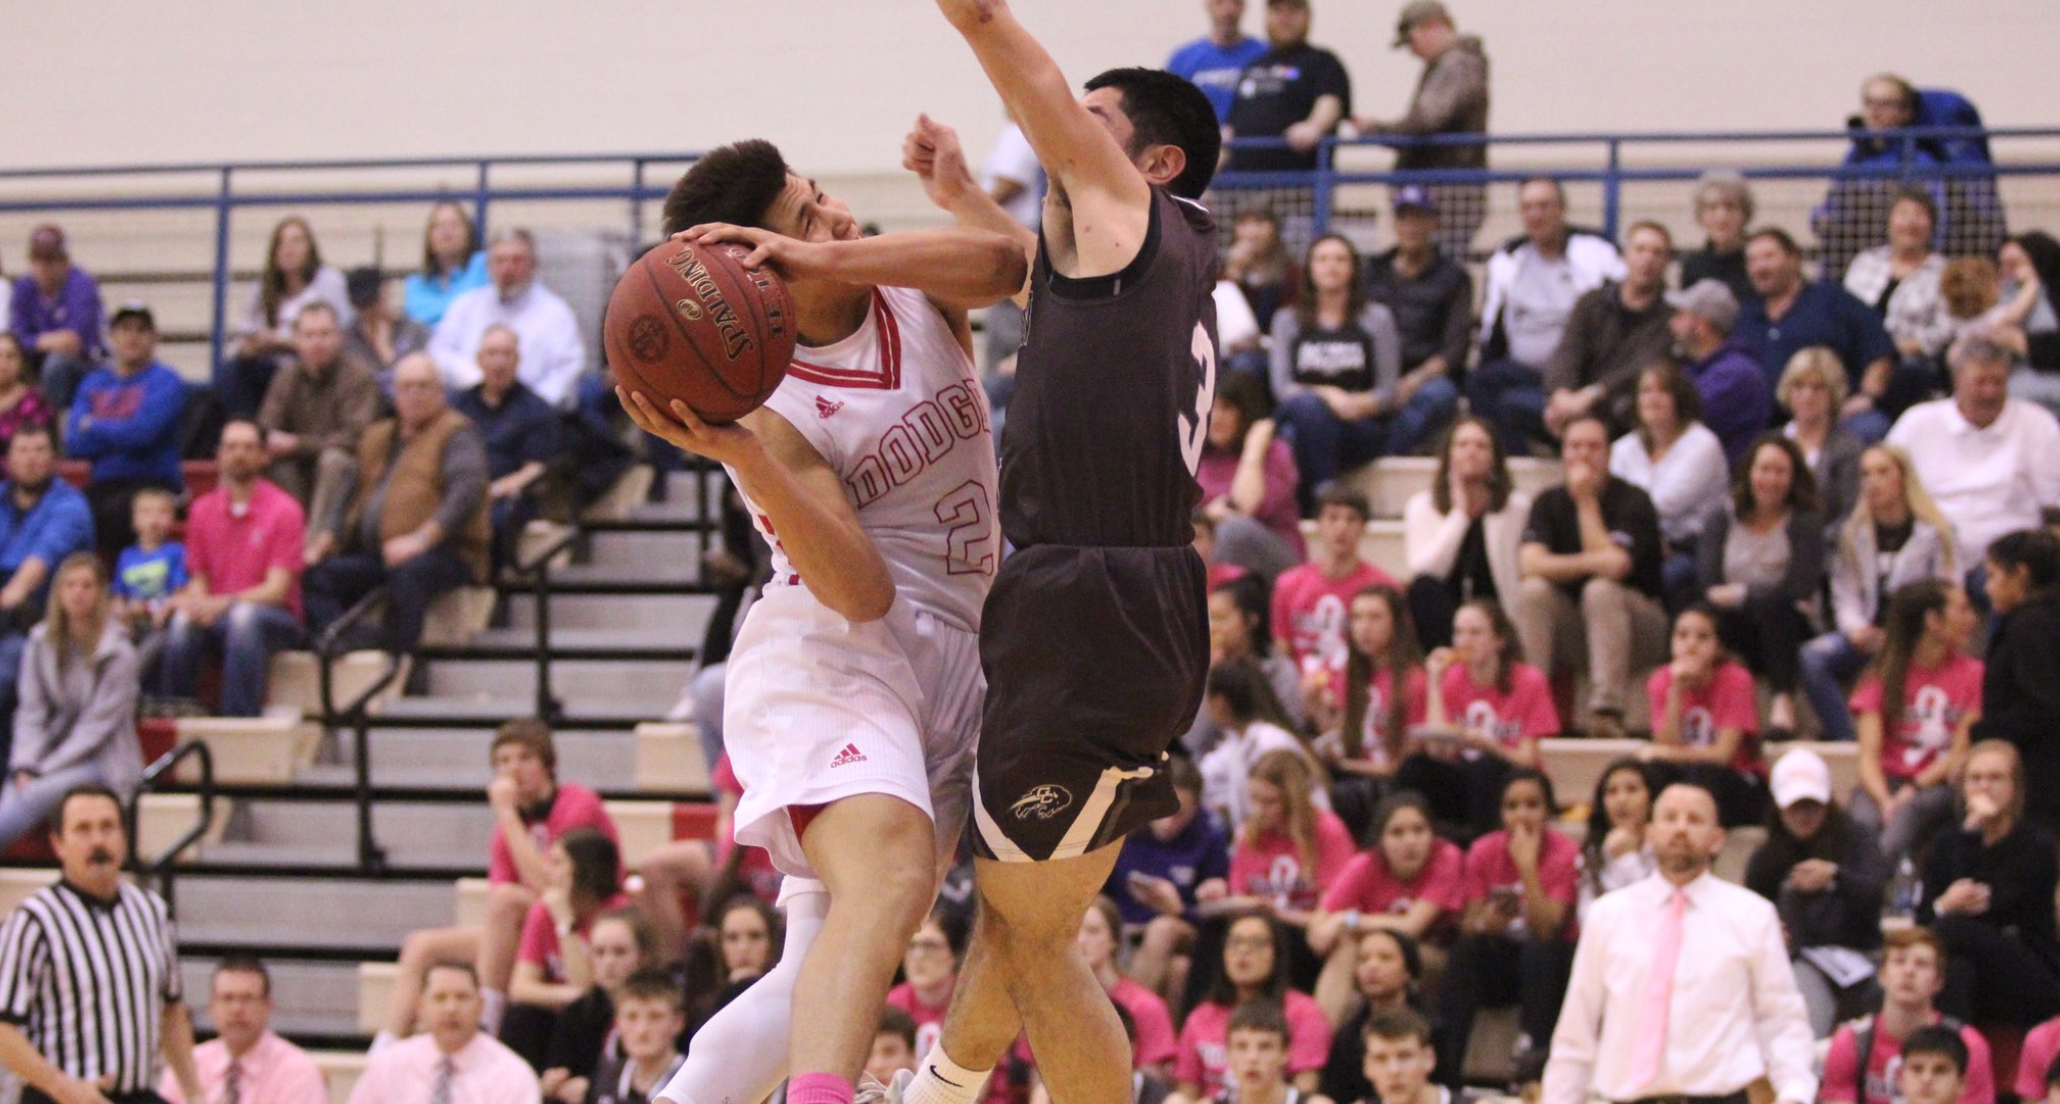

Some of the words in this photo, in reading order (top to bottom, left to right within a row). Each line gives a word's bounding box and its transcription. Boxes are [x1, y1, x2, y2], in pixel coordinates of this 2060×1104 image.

[666, 246, 753, 361] SPALDING
[1177, 320, 1216, 477] 3
[934, 479, 994, 576] 2
[830, 755, 867, 768] adidas
